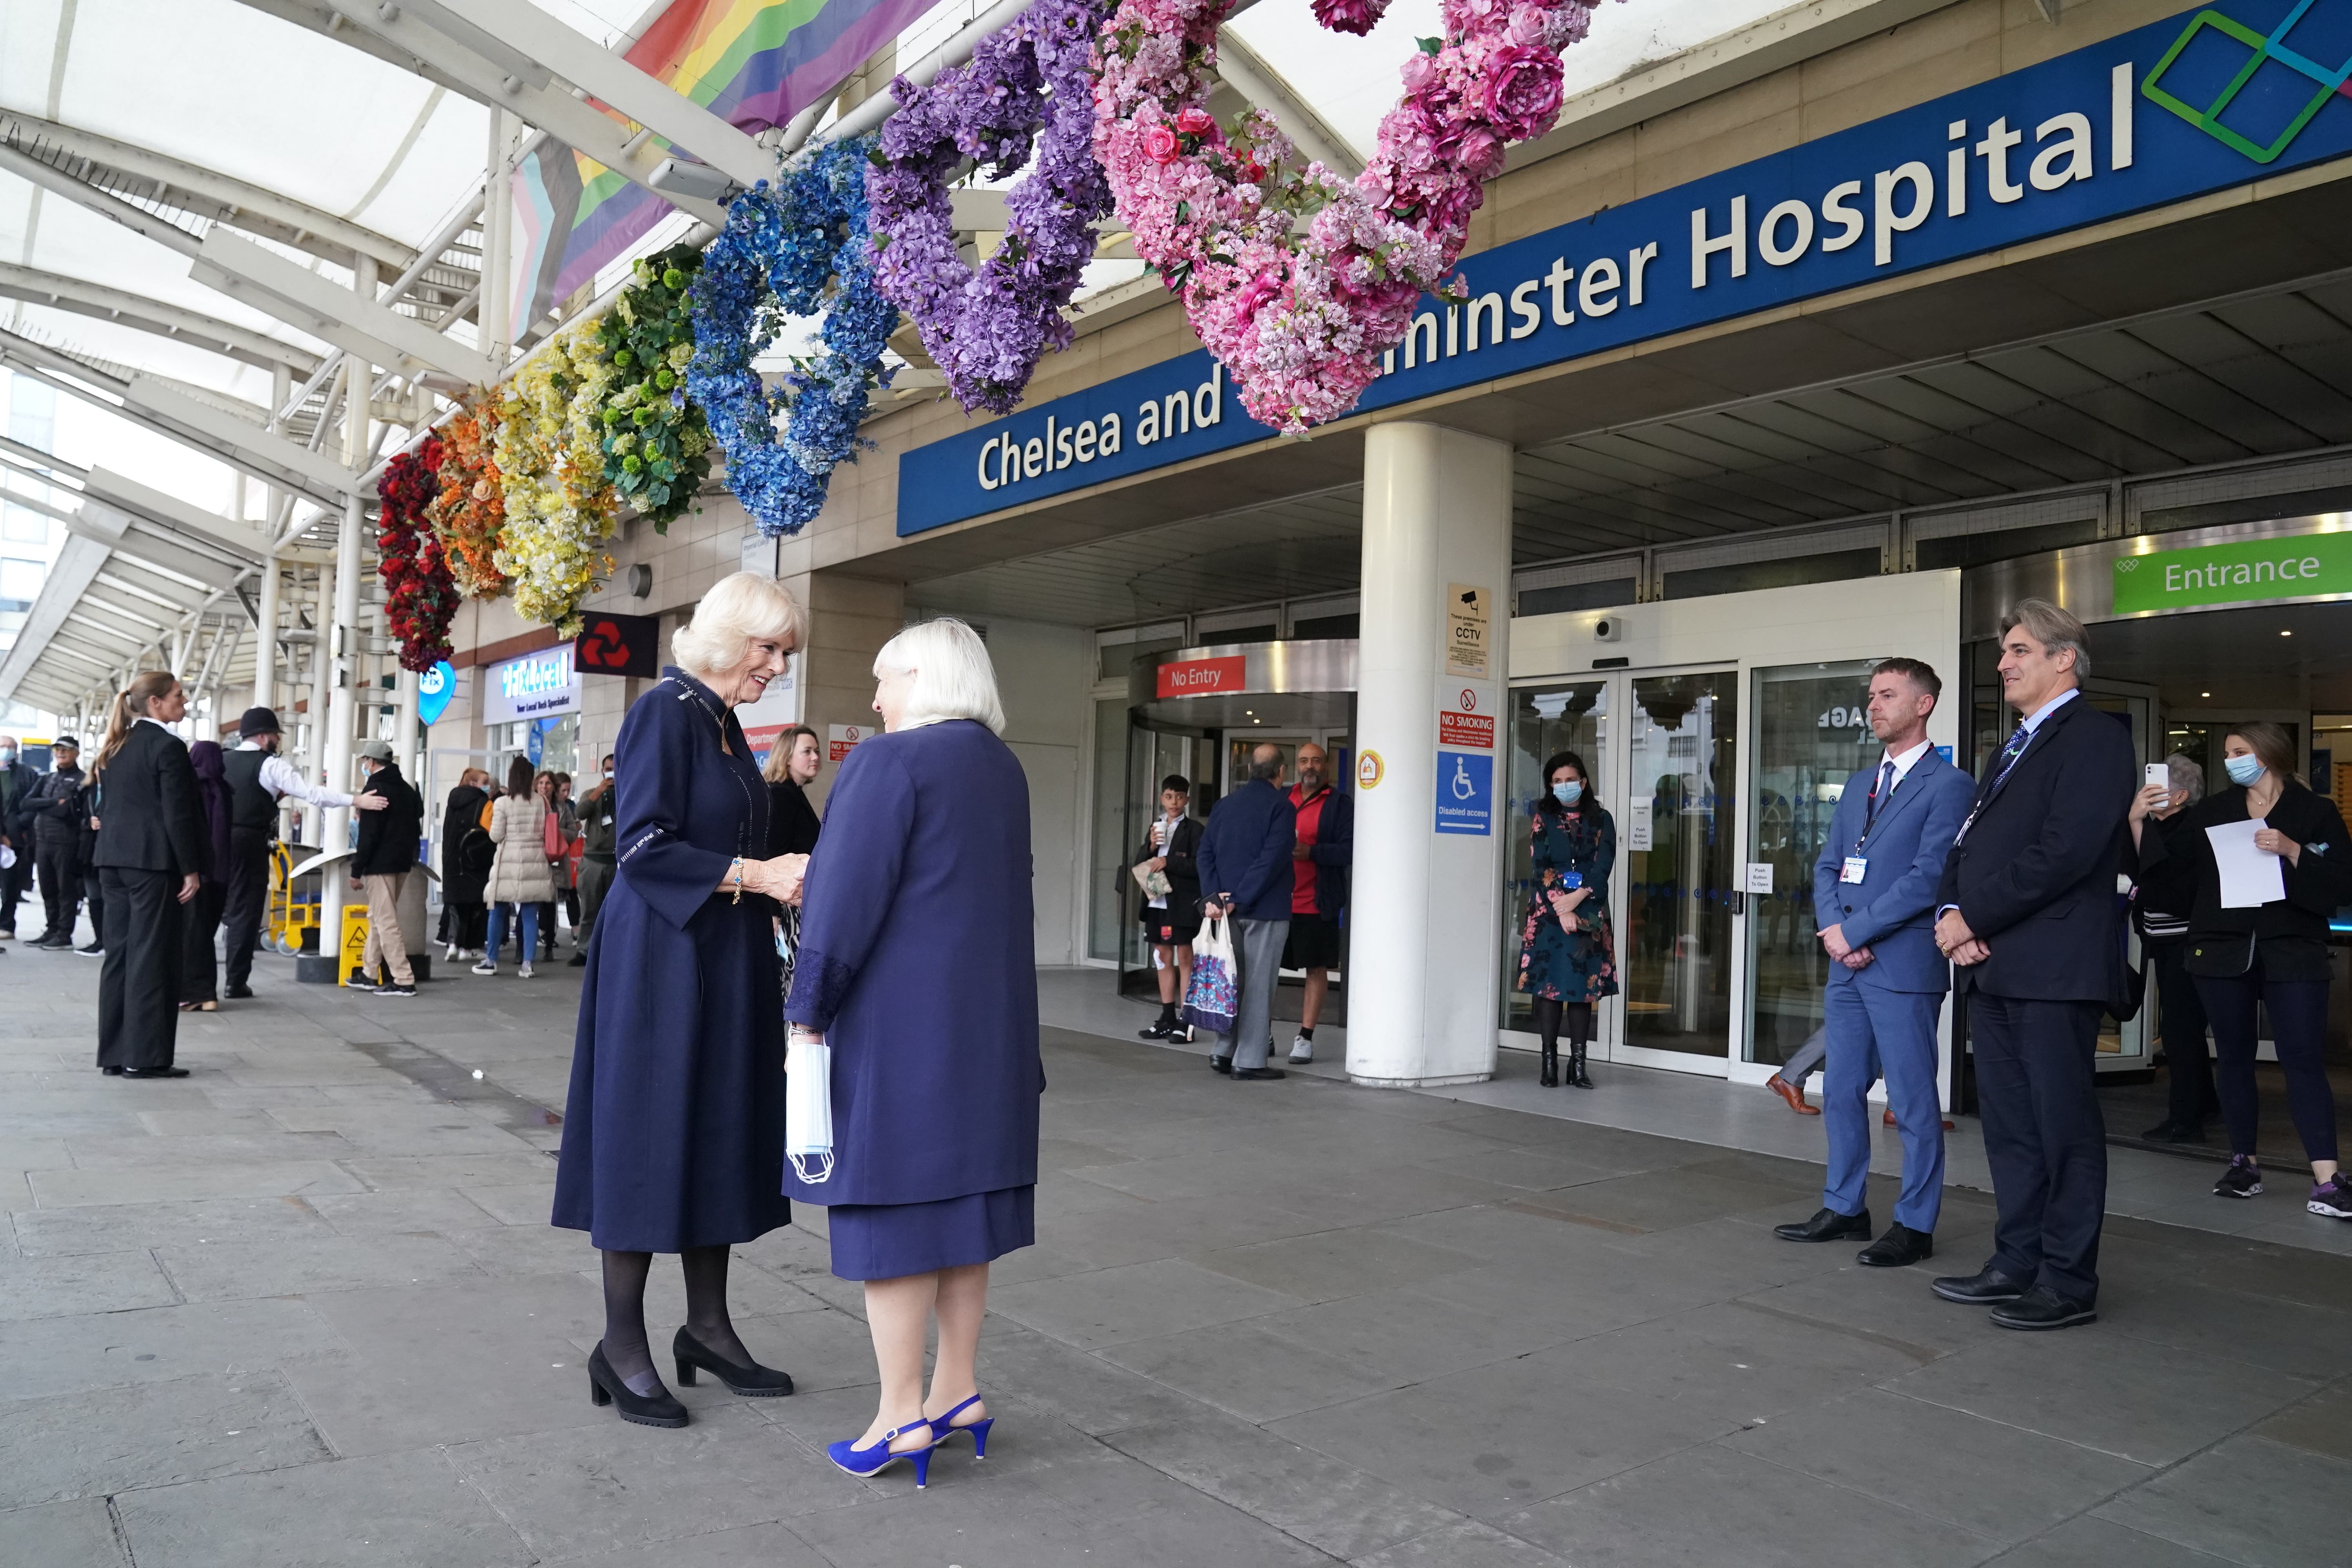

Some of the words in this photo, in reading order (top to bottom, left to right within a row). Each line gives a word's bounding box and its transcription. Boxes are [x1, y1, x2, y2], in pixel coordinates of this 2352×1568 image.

[978, 413, 1120, 490] Chelsea
[1136, 363, 1221, 445] and
[1691, 62, 2132, 289] Hospital
[2166, 557, 2319, 592] Entrance
[1456, 627, 1480, 640] CCTV
[512, 652, 568, 697] FixLocal
[1172, 671, 1187, 687] No
[1189, 668, 1221, 687] Entry
[1442, 715, 1454, 726] NO
[1457, 717, 1492, 730] SMOKING
[1439, 807, 1465, 816] Disabled
